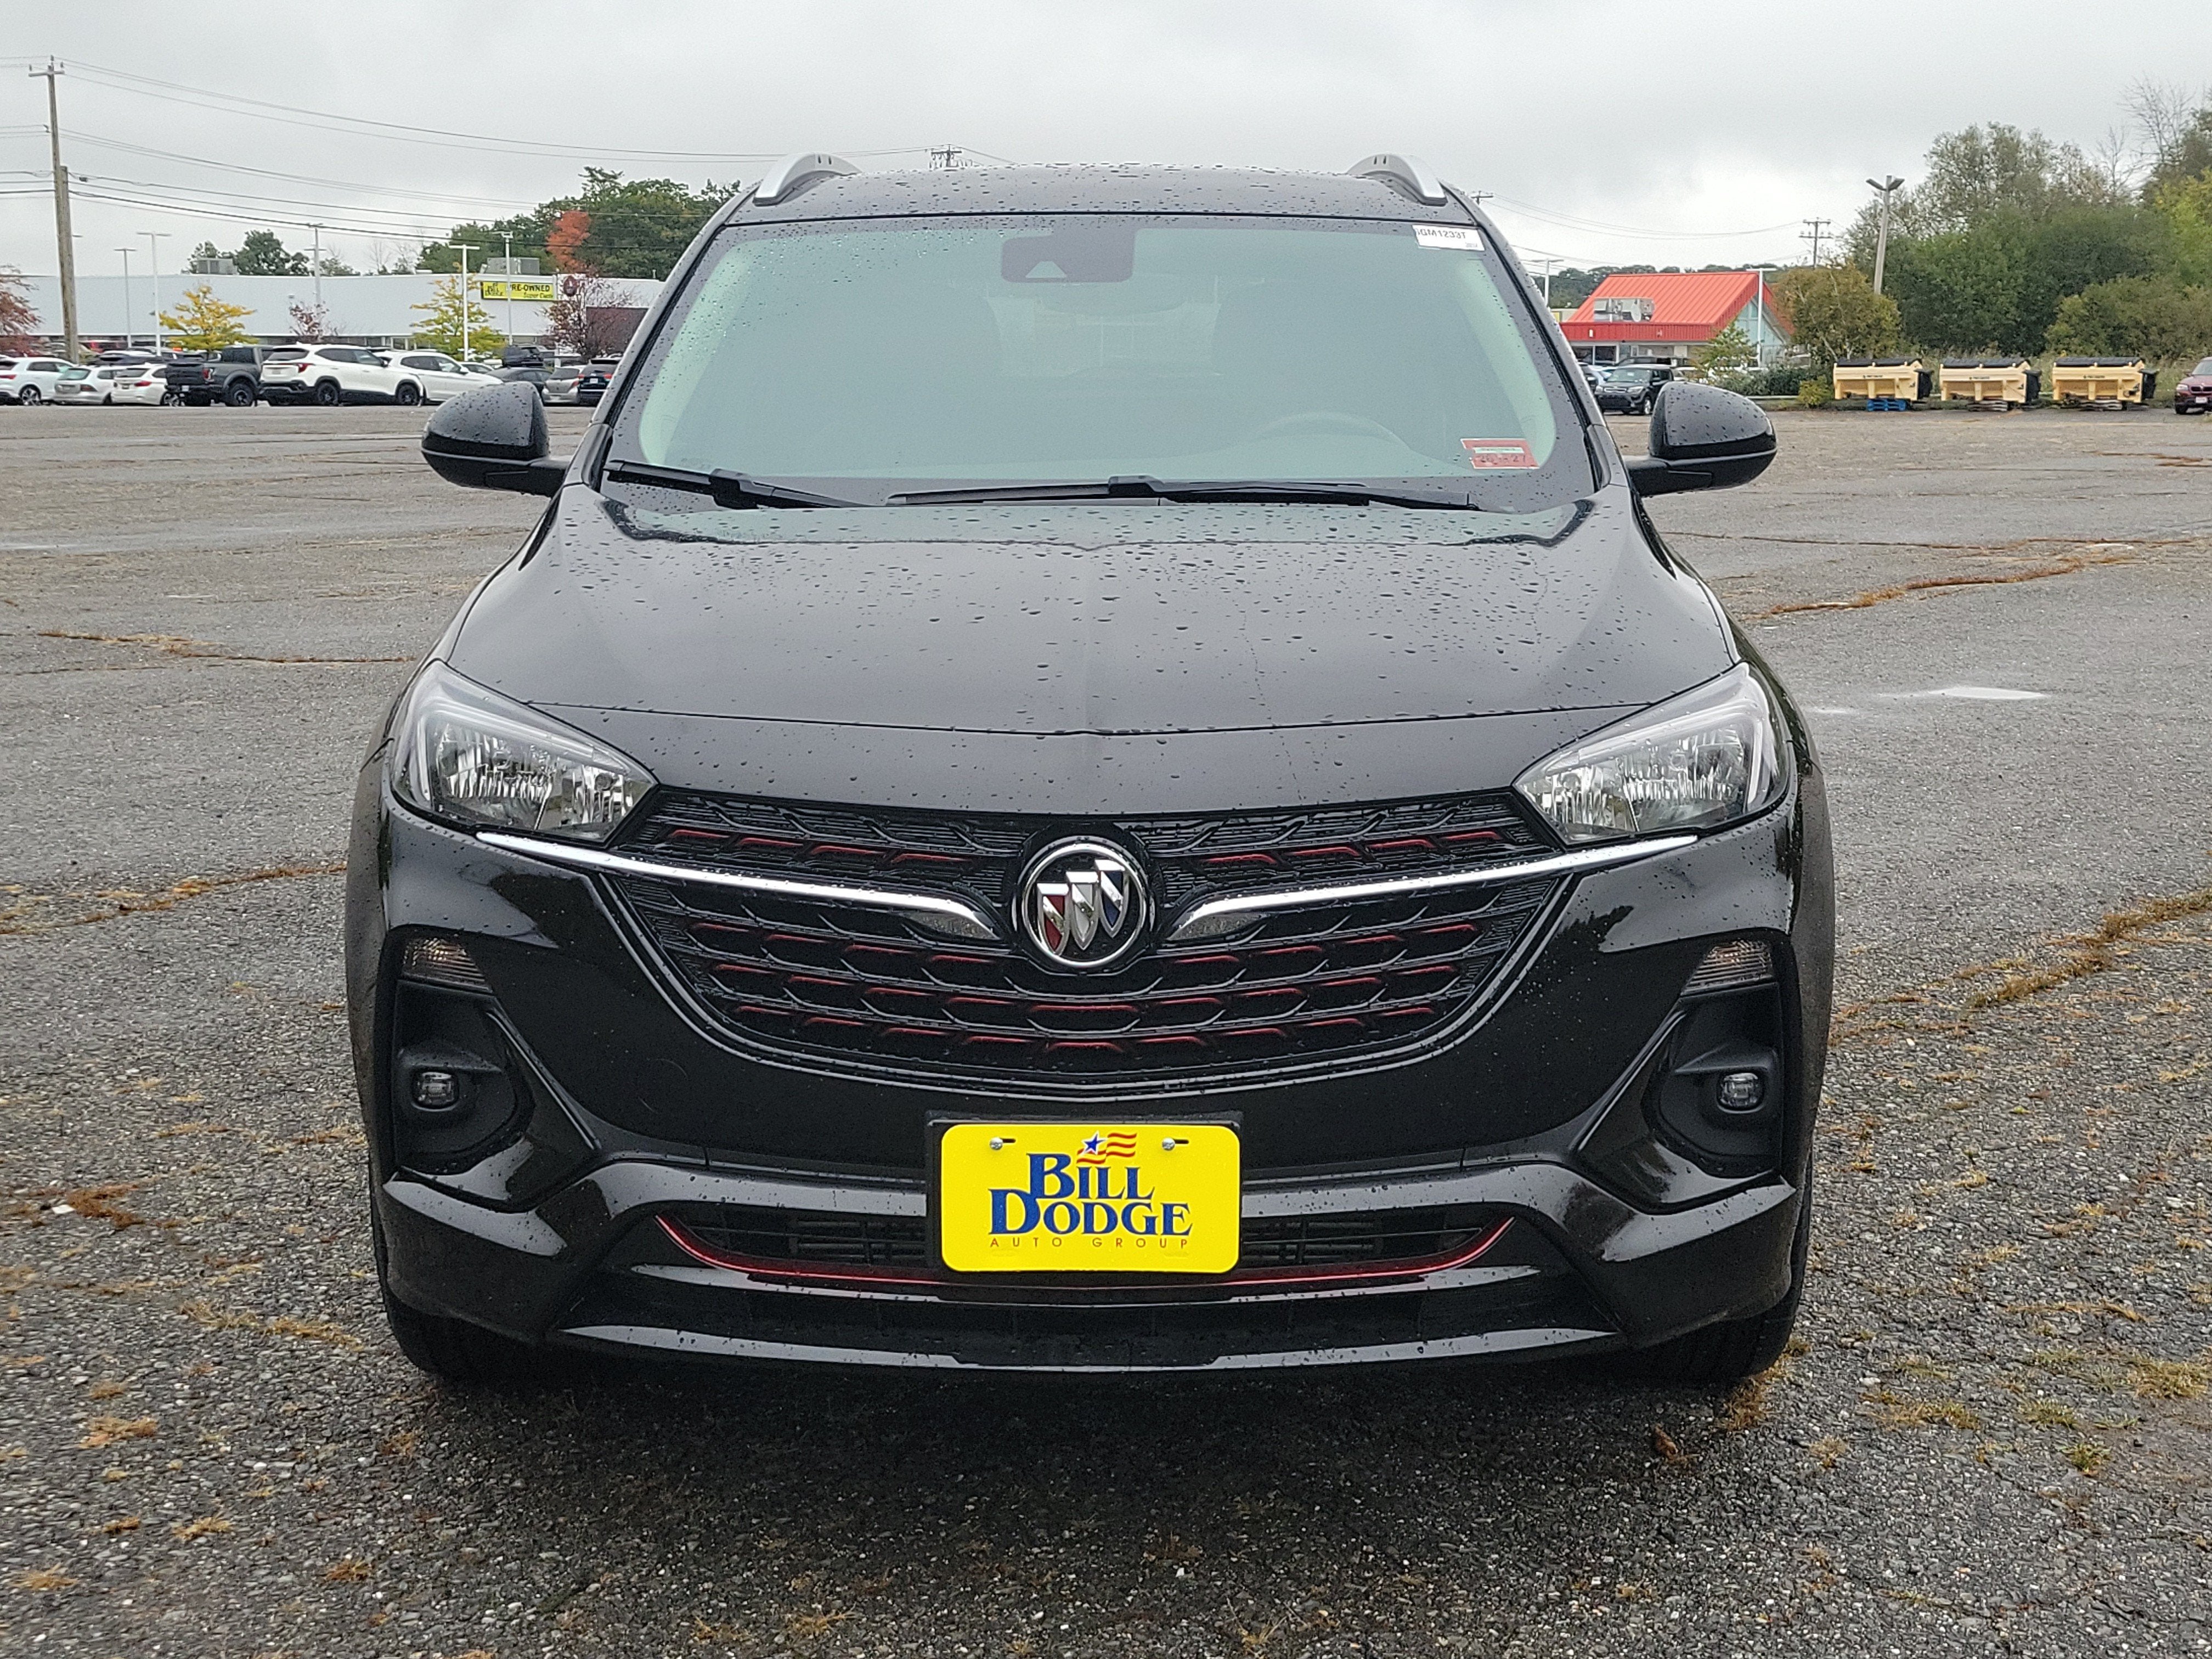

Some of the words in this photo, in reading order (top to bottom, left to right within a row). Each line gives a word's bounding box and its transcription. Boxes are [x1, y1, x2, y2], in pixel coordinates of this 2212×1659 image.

[1026, 1153, 1155, 1200] BILL
[988, 1188, 1193, 1236] DODGE
[990, 1237, 1063, 1248] AUTO
[1092, 1237, 1188, 1249] GROUP
